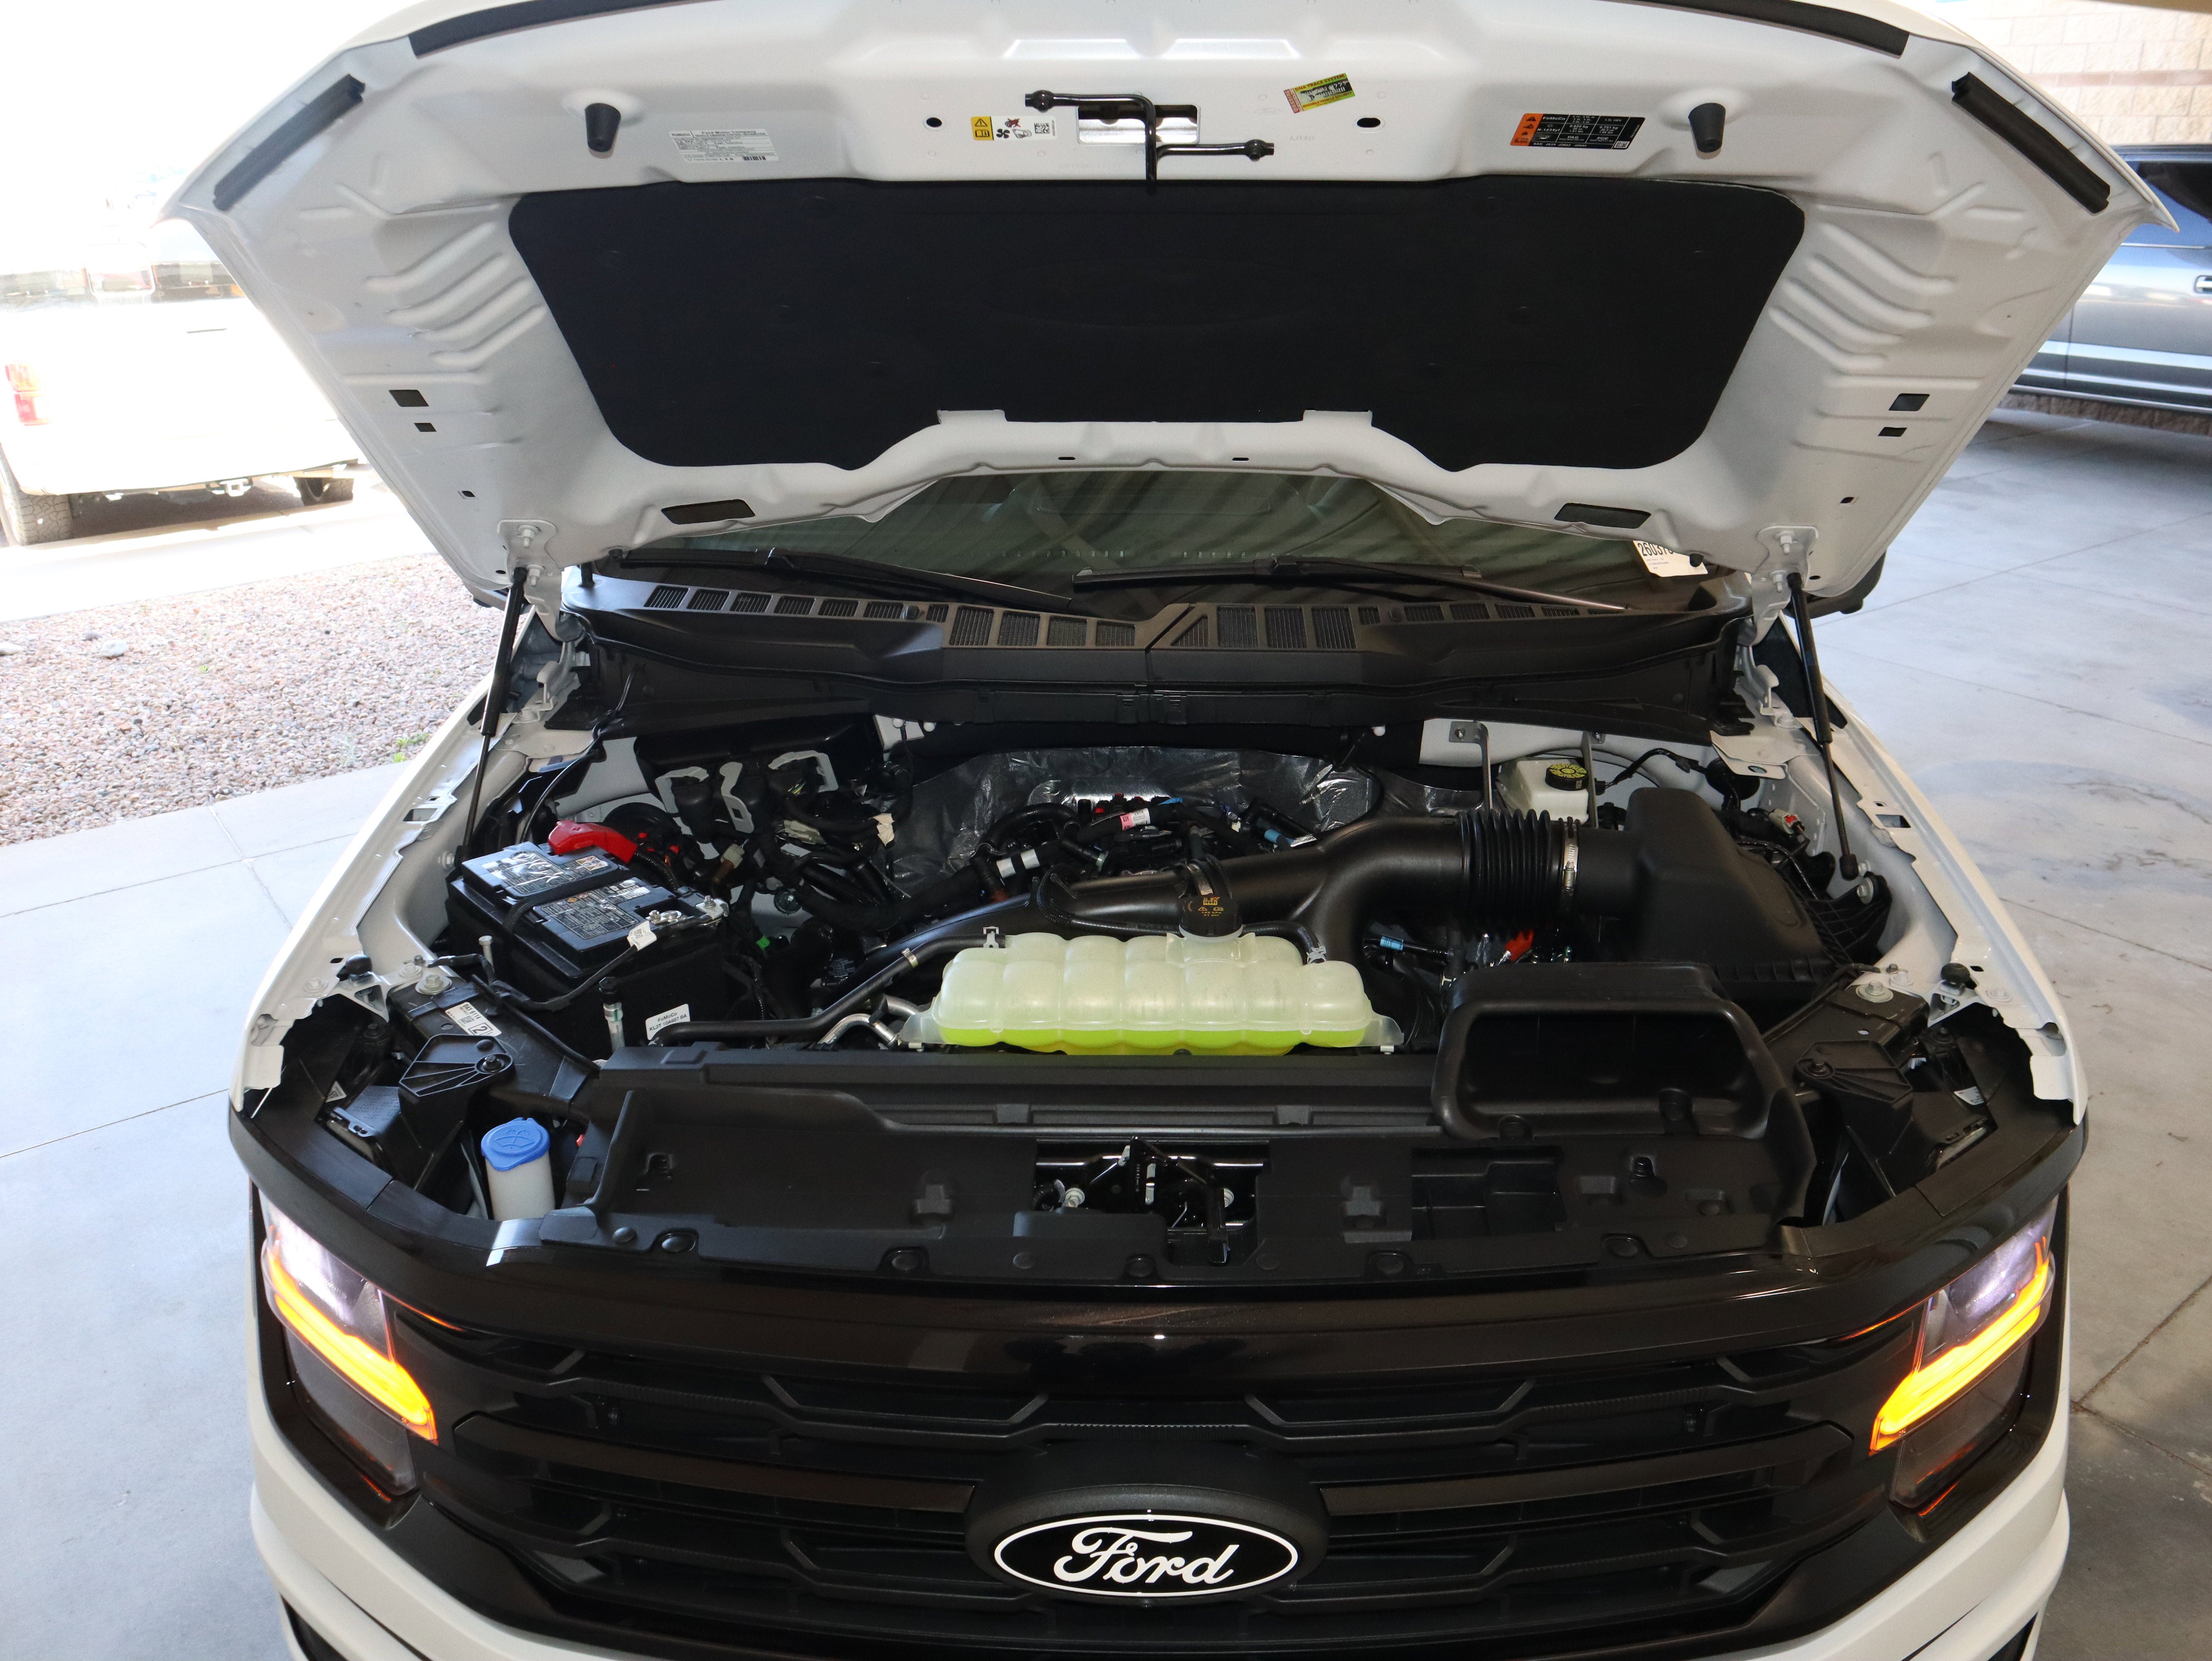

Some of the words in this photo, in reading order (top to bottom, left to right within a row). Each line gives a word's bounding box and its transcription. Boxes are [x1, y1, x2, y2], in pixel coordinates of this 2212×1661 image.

[470, 1010, 482, 1019] 6114
[658, 1012, 677, 1022] FoMoCo
[1054, 1527, 1239, 1584] Ford
